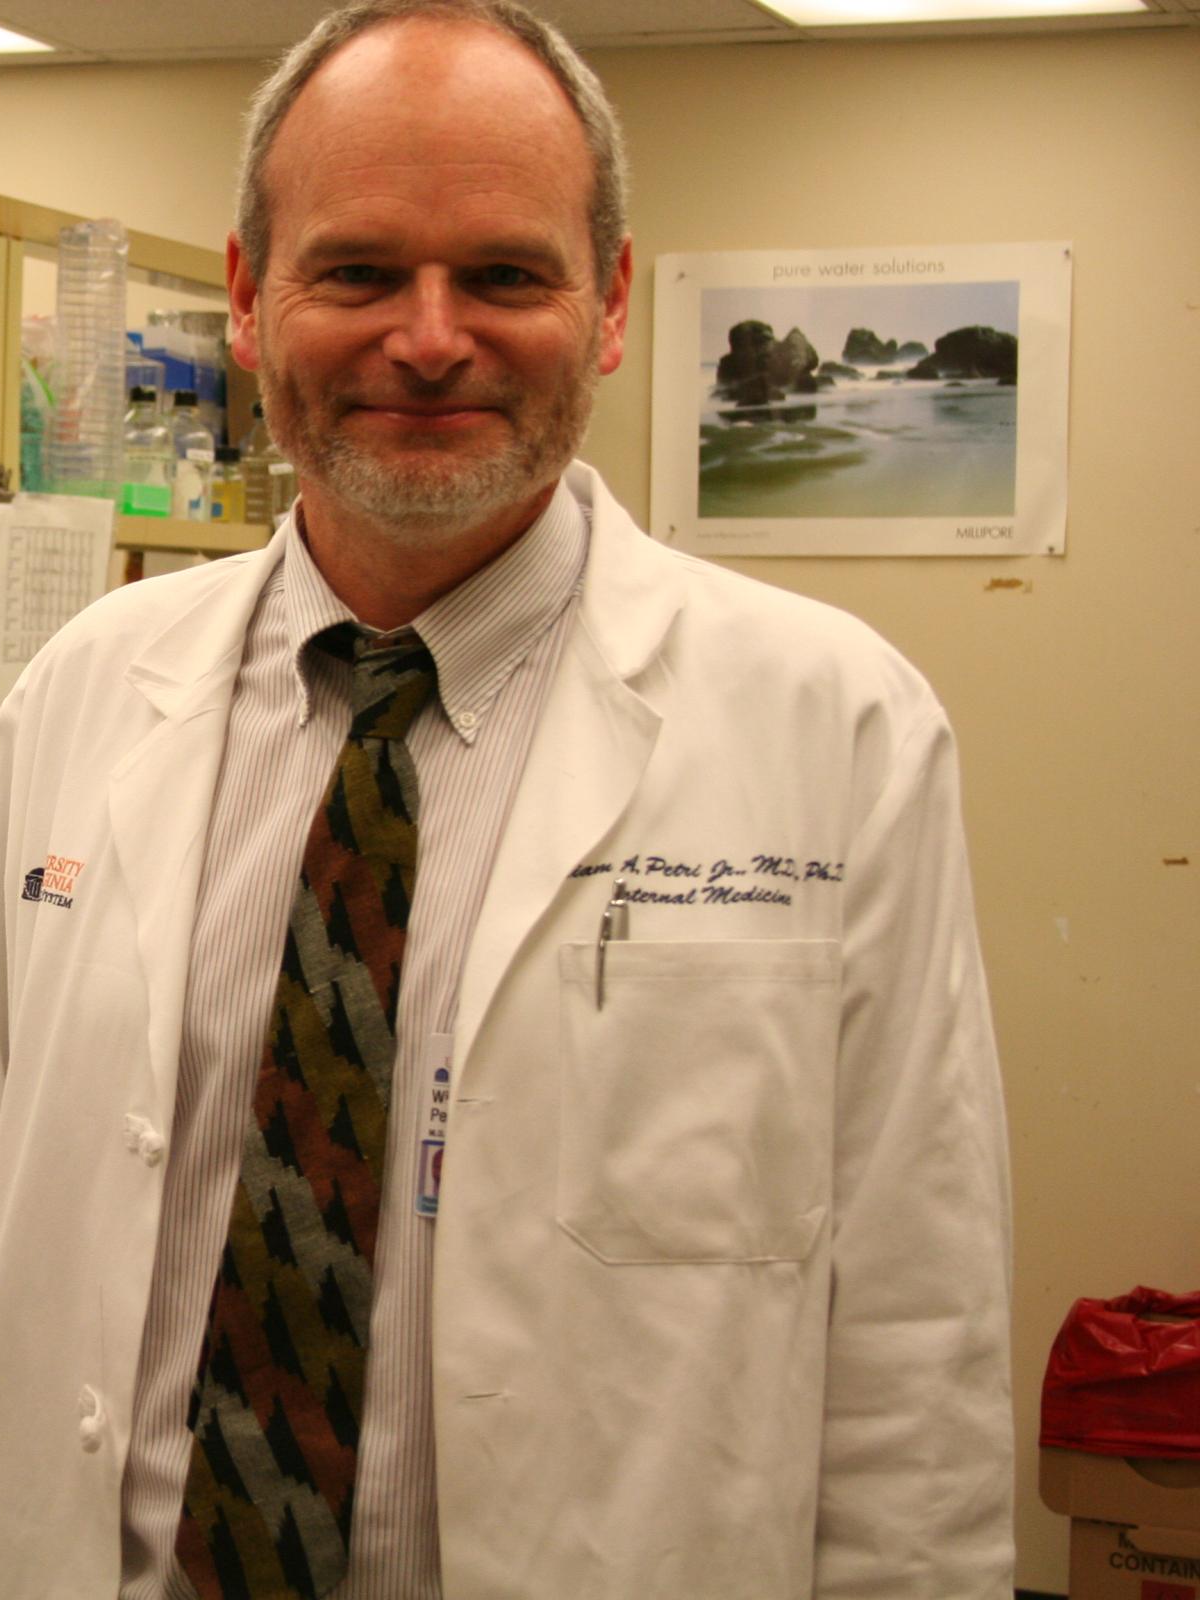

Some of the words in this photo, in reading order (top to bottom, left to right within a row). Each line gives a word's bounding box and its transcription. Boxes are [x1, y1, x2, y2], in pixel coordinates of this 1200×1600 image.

[772, 263, 811, 281] pure
[818, 261, 864, 277] water
[872, 256, 946, 276] solutions
[956, 526, 1013, 540] MILLIPORE
[645, 856, 701, 879] Petri
[616, 885, 698, 906] nternal
[701, 885, 793, 907] Medicine
